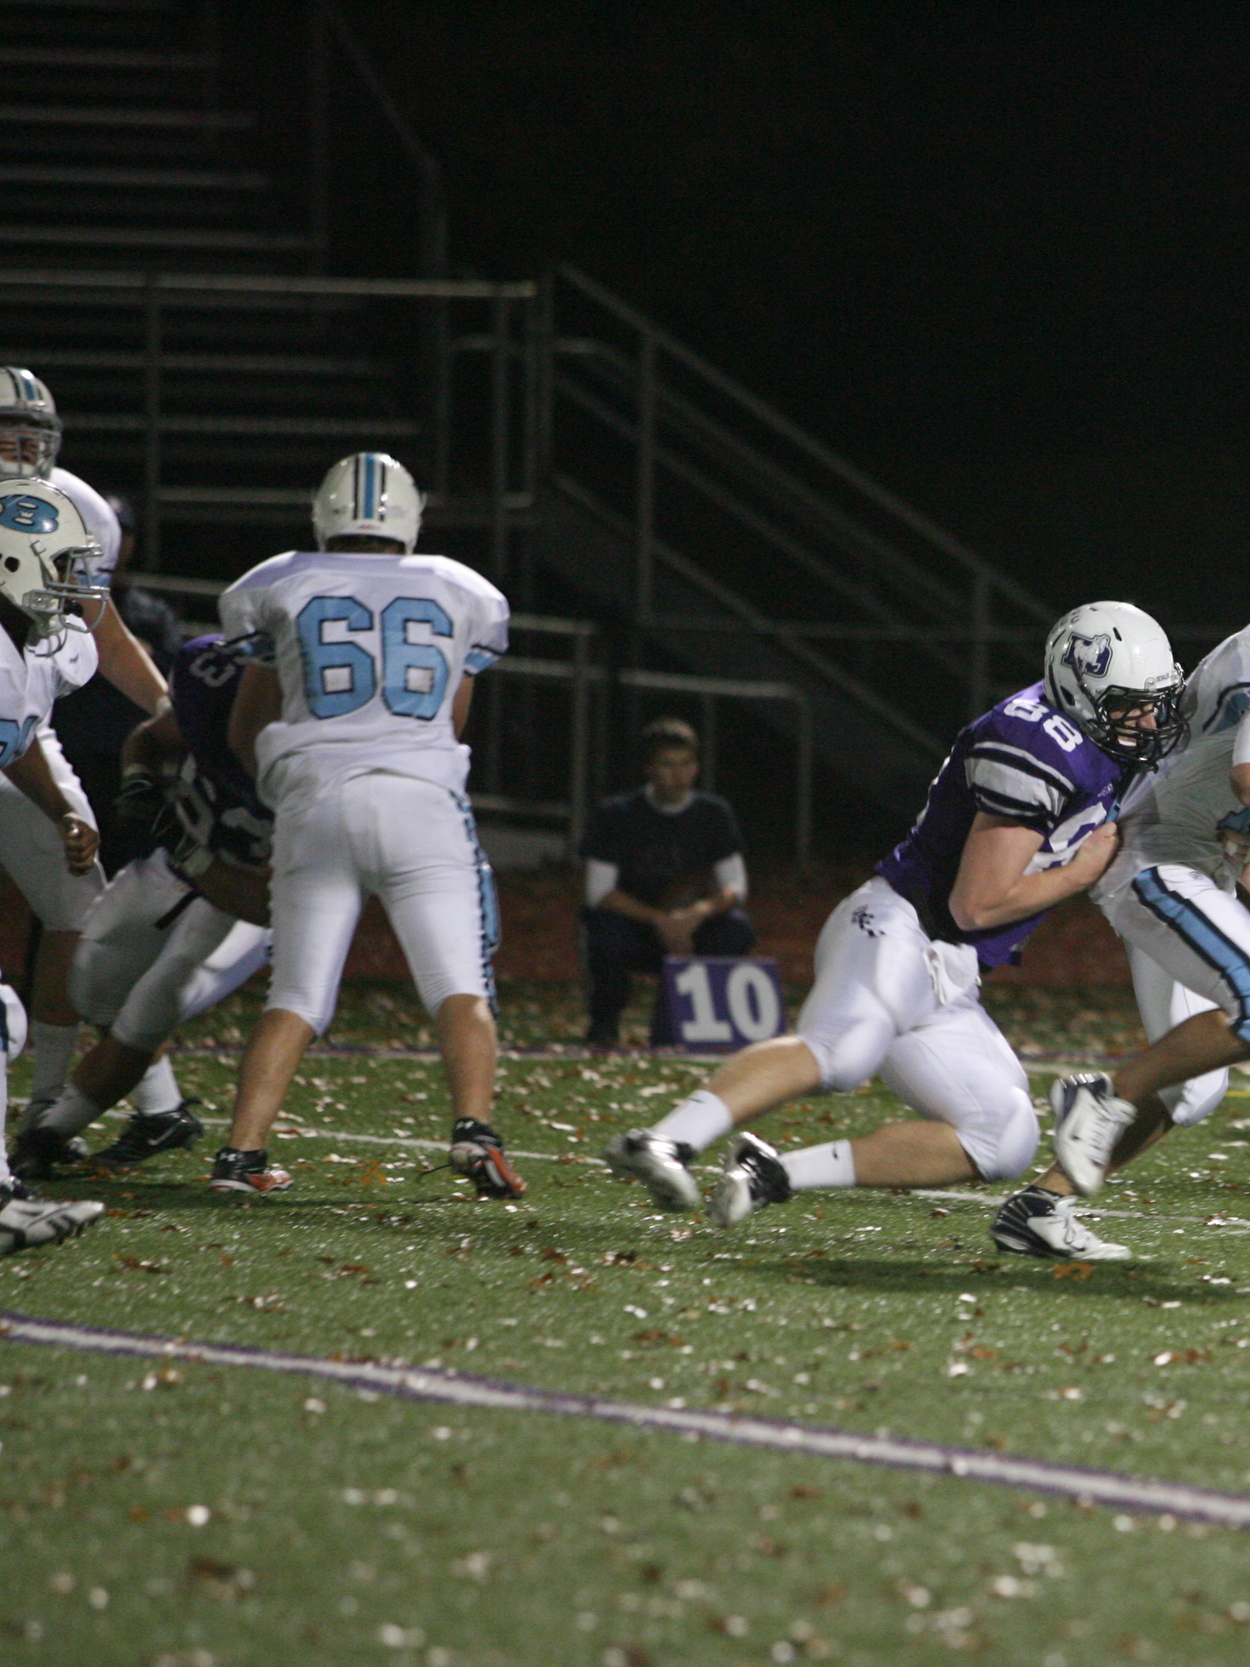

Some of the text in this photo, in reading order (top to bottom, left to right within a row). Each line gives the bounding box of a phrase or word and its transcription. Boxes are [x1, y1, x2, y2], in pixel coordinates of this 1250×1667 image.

[297, 596, 453, 720] 66
[1003, 698, 1084, 753] 88
[675, 961, 779, 1042] 10
